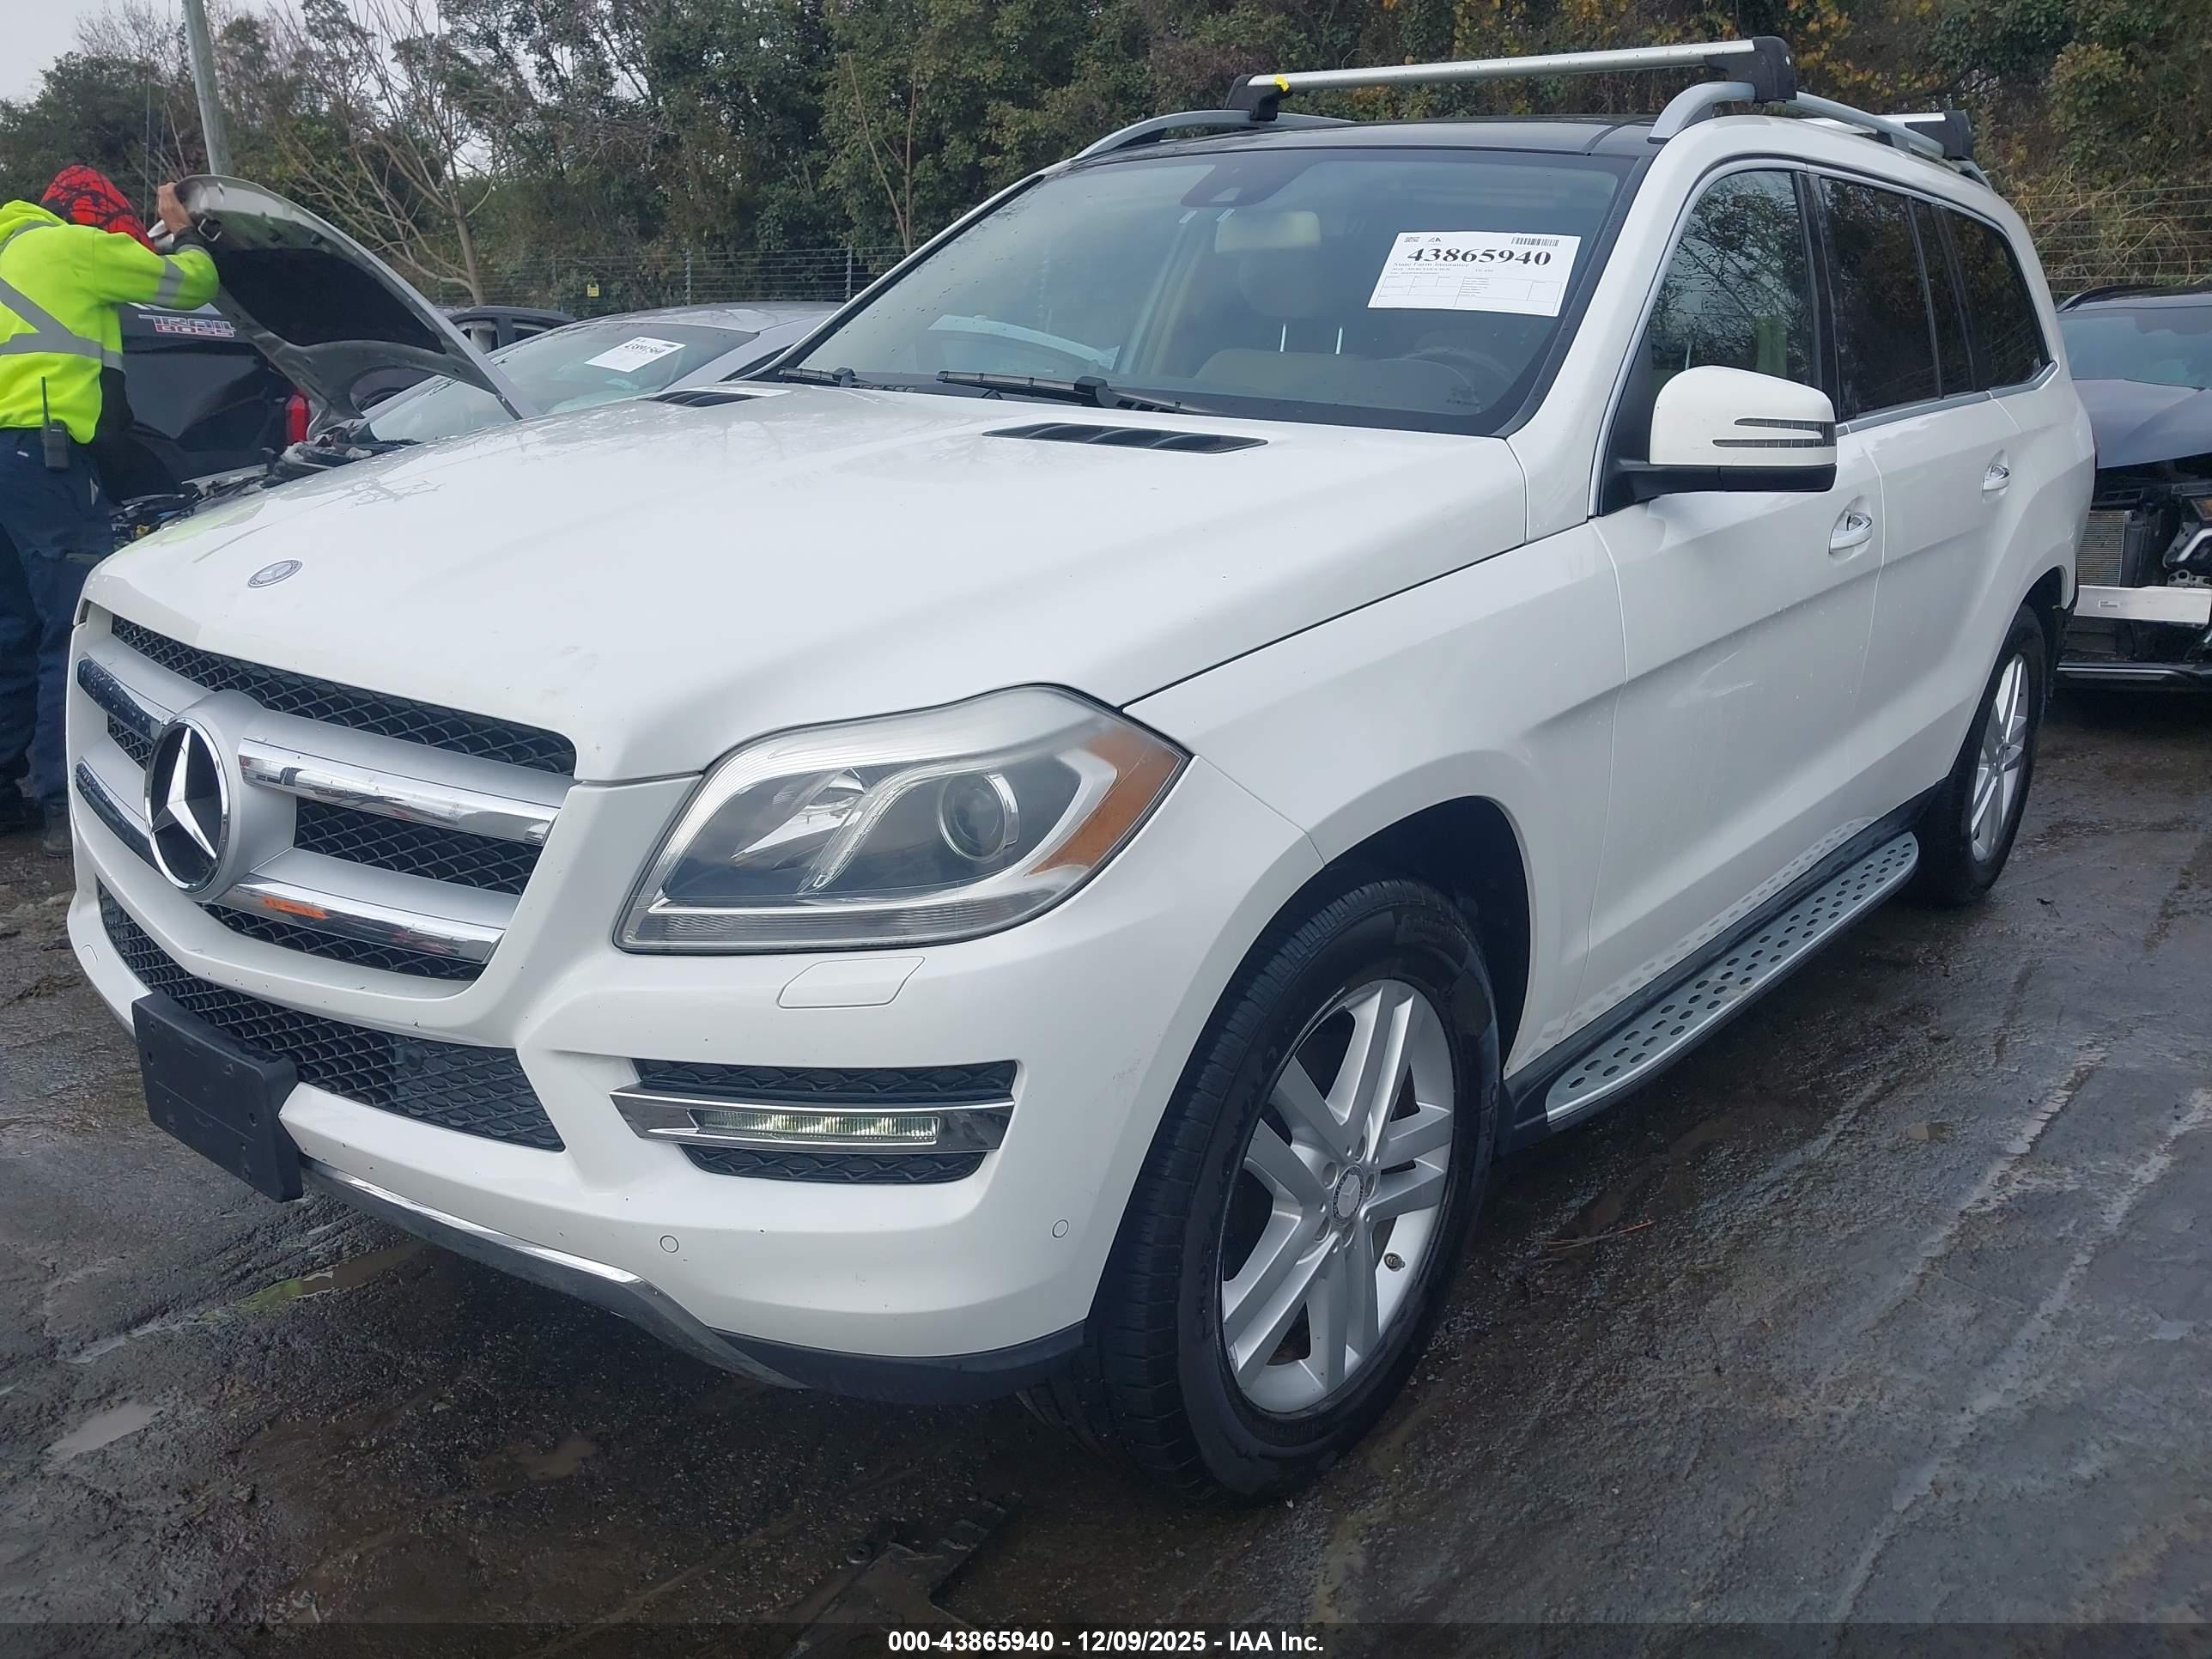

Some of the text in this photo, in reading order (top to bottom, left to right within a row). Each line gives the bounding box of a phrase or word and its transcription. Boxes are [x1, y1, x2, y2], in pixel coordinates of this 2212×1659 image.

[1407, 247, 1552, 266] 43865940
[138, 313, 236, 331] TRAIL
[155, 324, 235, 337] BOSS
